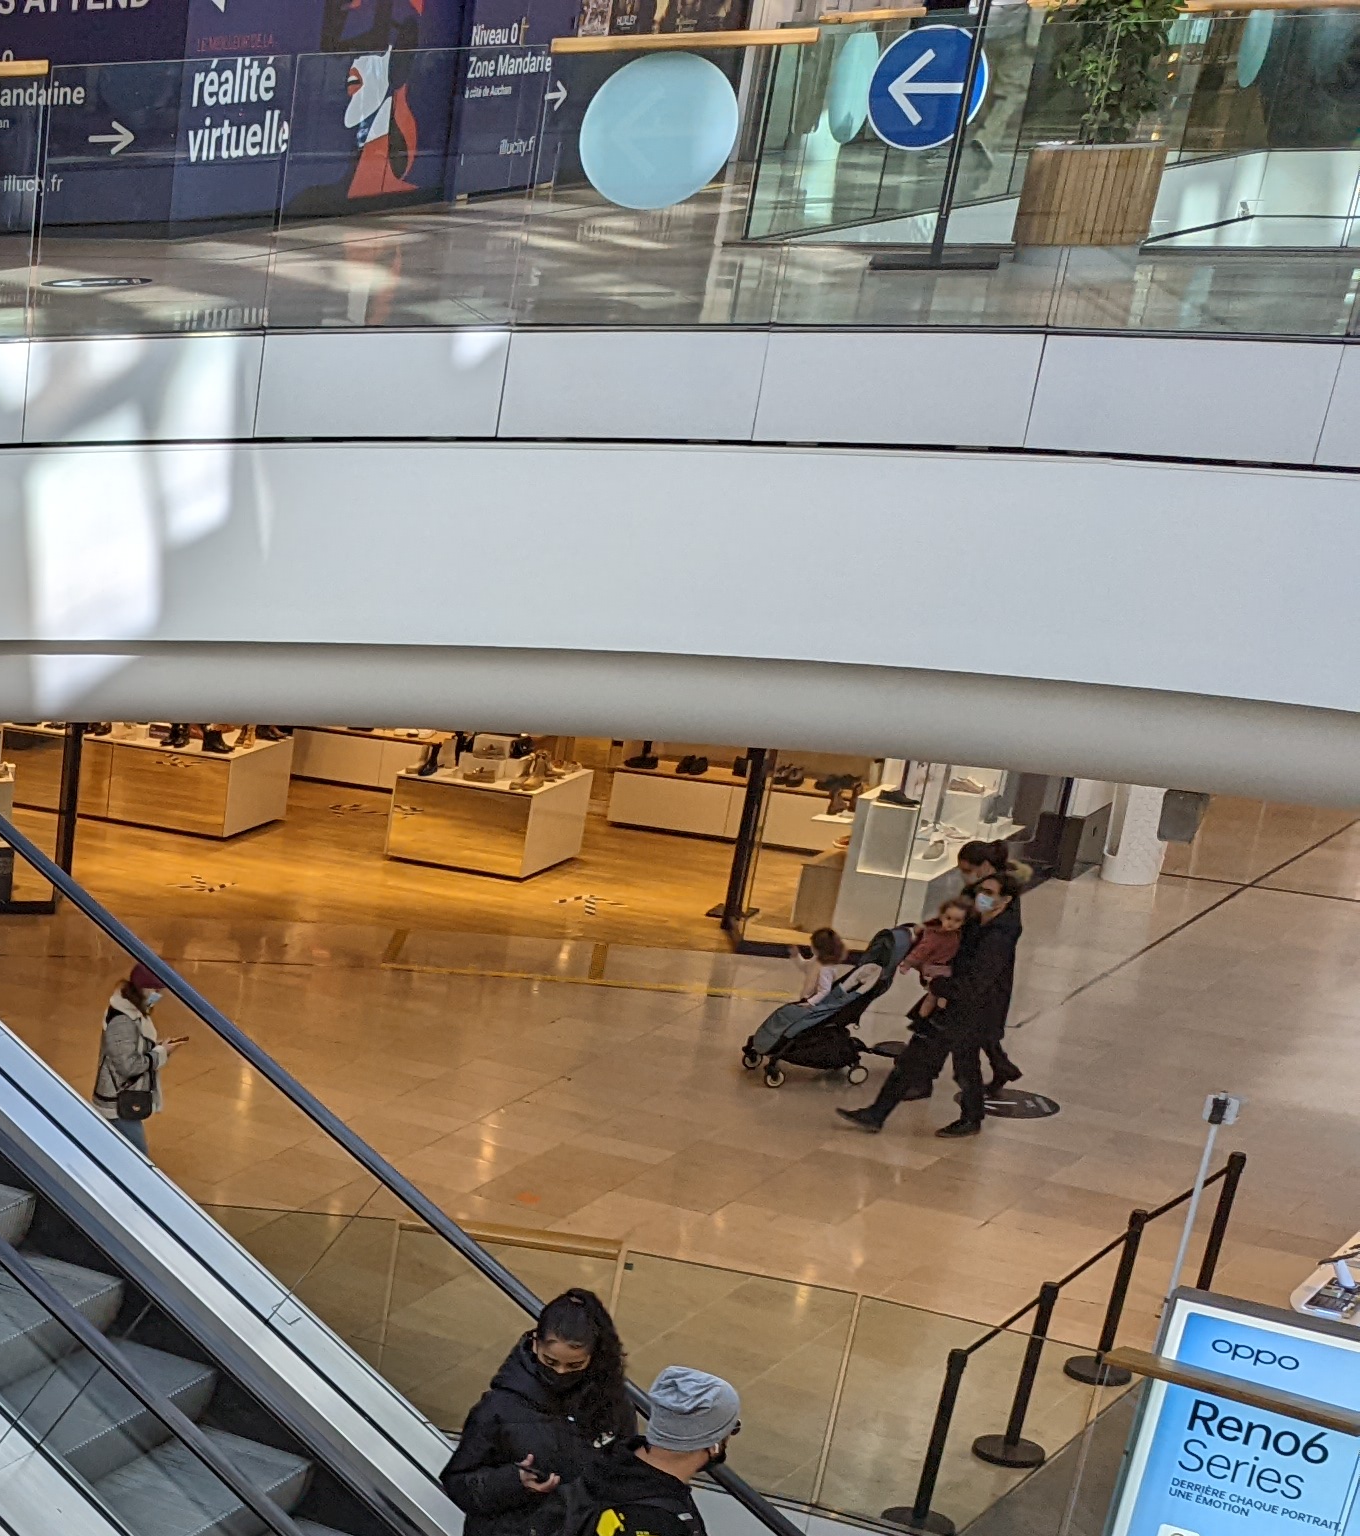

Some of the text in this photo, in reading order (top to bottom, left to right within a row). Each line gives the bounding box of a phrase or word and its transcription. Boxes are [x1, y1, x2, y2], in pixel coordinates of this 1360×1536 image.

[471, 22, 518, 46] Niveau 0
[192, 57, 277, 107] réalité
[467, 51, 552, 79] Zone Mandarie
[188, 110, 289, 162] virtuelle
[3, 174, 64, 196] illucty.fr
[1211, 1338, 1300, 1372] oppo
[1187, 1398, 1329, 1465] Reno6
[1177, 1438, 1305, 1501] Series
[1168, 1486, 1251, 1517] UNE ÉMOTION
[1171, 1477, 1226, 1500] DERRIÈRE
[1228, 1493, 1280, 1515] CHAQUE
